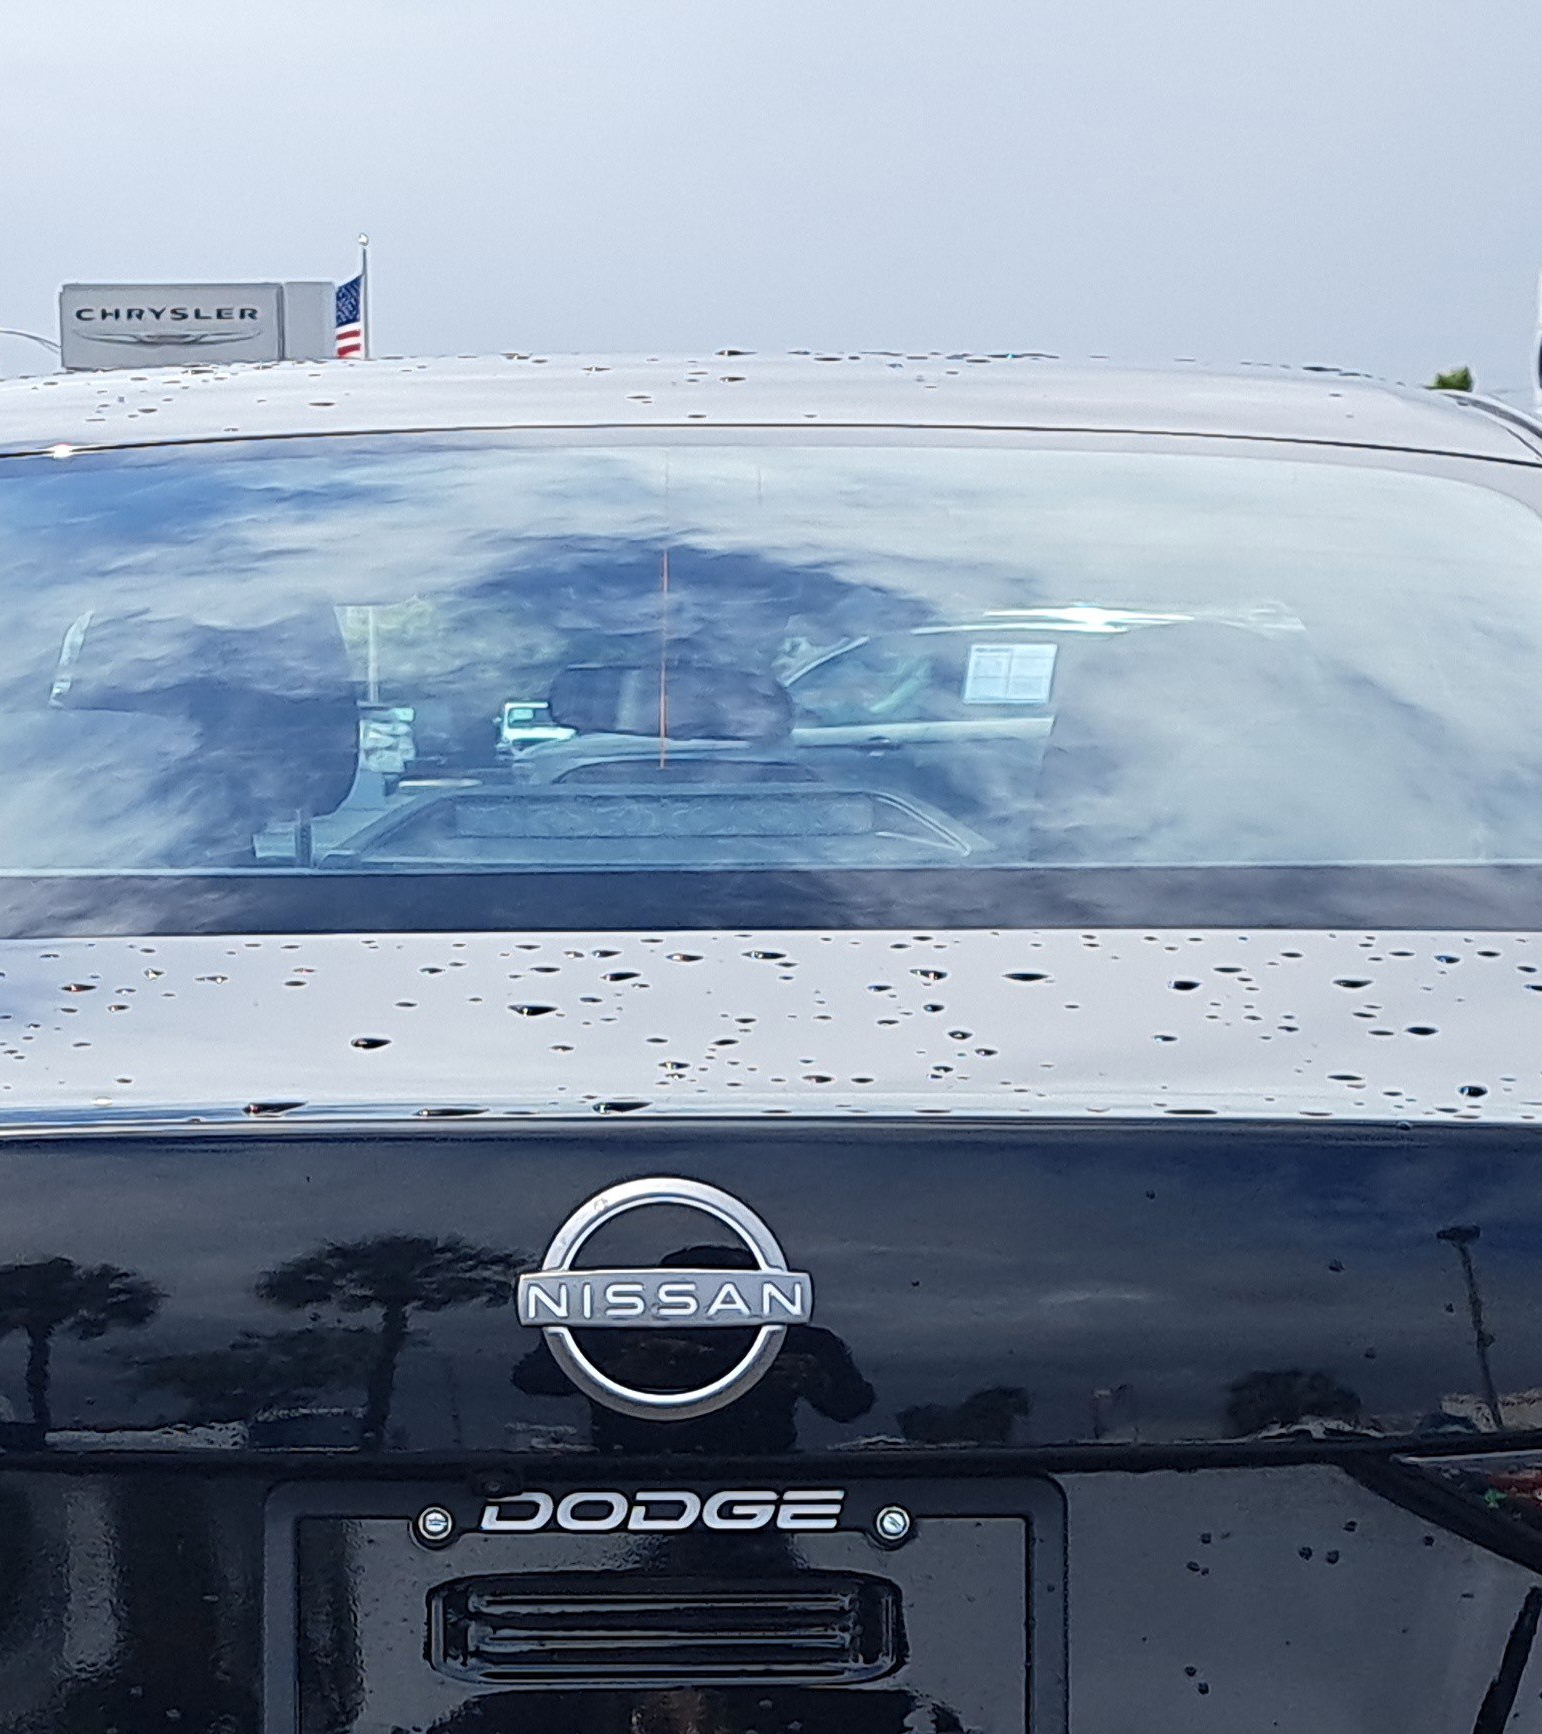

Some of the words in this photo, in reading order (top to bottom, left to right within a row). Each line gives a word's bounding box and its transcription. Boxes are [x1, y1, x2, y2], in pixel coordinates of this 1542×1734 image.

[75, 307, 259, 321] CHRYSLER
[527, 1282, 805, 1320] NISSAN
[480, 1491, 845, 1531] DODGE
